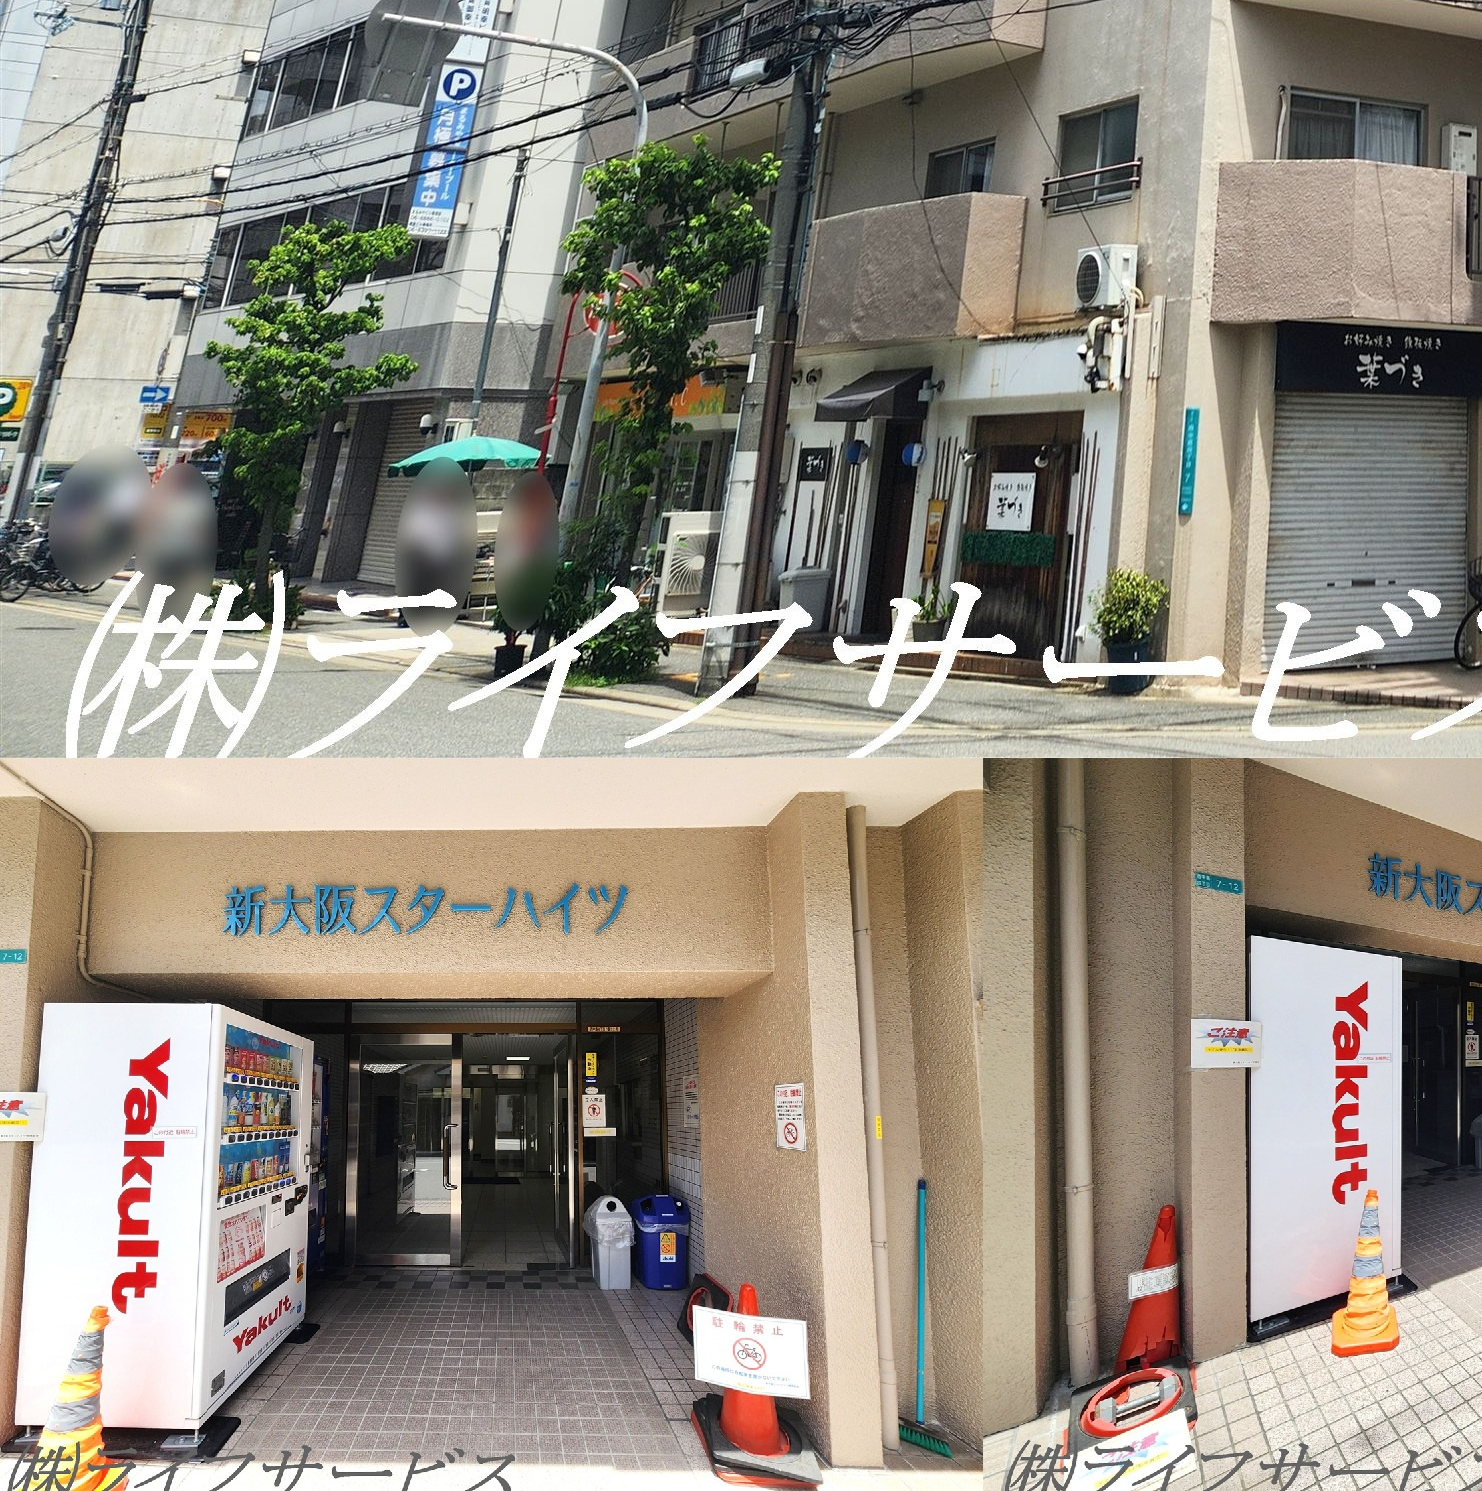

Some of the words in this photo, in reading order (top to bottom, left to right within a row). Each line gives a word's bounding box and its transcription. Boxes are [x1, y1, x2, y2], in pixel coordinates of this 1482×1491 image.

[449, 72, 472, 96] P
[1356, 353, 1424, 389] 葉づき
[1216, 879, 1239, 891] 7-12
[224, 883, 630, 937] 新大阪スターハイツ
[3, 952, 23, 961] 7-12
[1207, 1027, 1250, 1039] ご注意
[1332, 981, 1368, 1205] Yakult
[112, 1037, 171, 1314] Yakult
[232, 1294, 293, 1354] Yakult
[712, 1316, 784, 1337] 駐輪禁止
